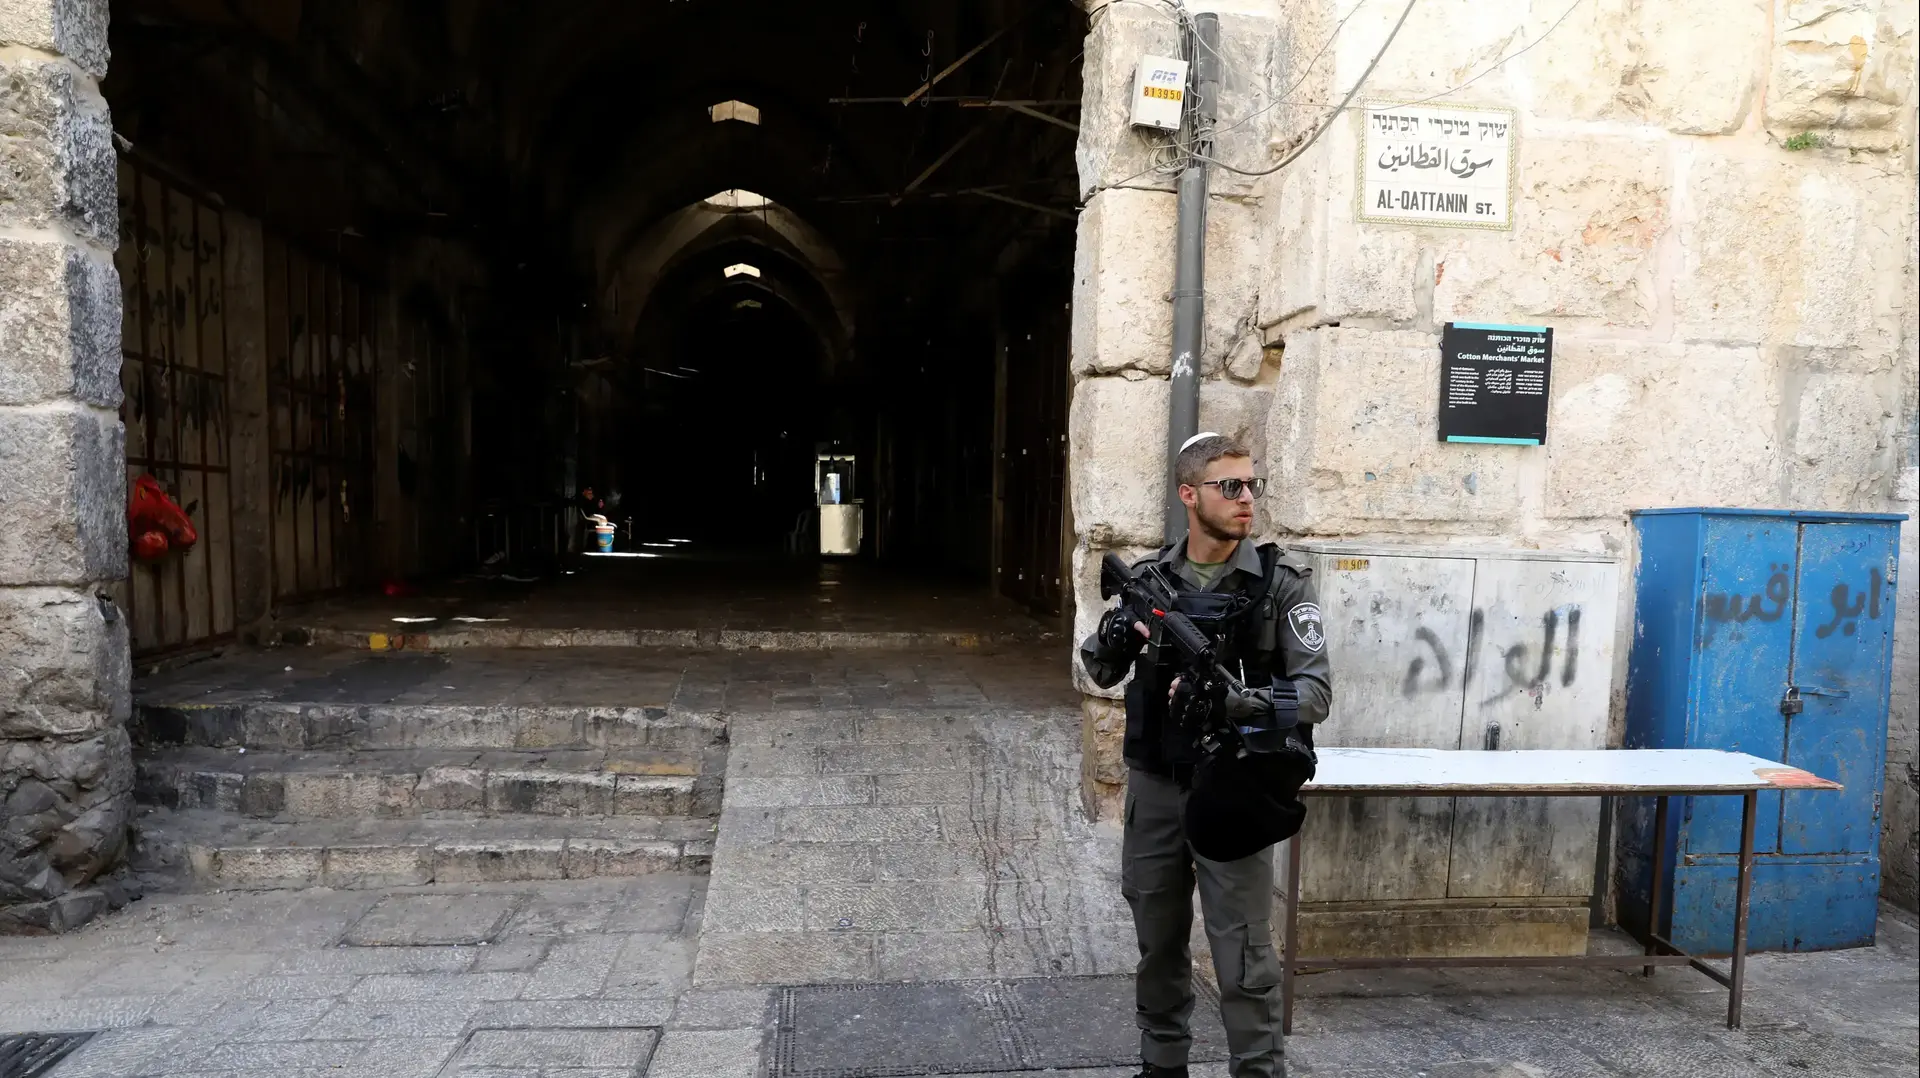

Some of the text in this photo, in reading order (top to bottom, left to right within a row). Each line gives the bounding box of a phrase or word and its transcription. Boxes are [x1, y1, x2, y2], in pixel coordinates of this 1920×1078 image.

[1144, 86, 1182, 101] 813950
[1378, 143, 1494, 178] سوق القطانين
[1377, 189, 1496, 216] AL-QATTANIN ST.
[1457, 352, 1481, 360] Cotton
[1527, 345, 1545, 355] سوق
